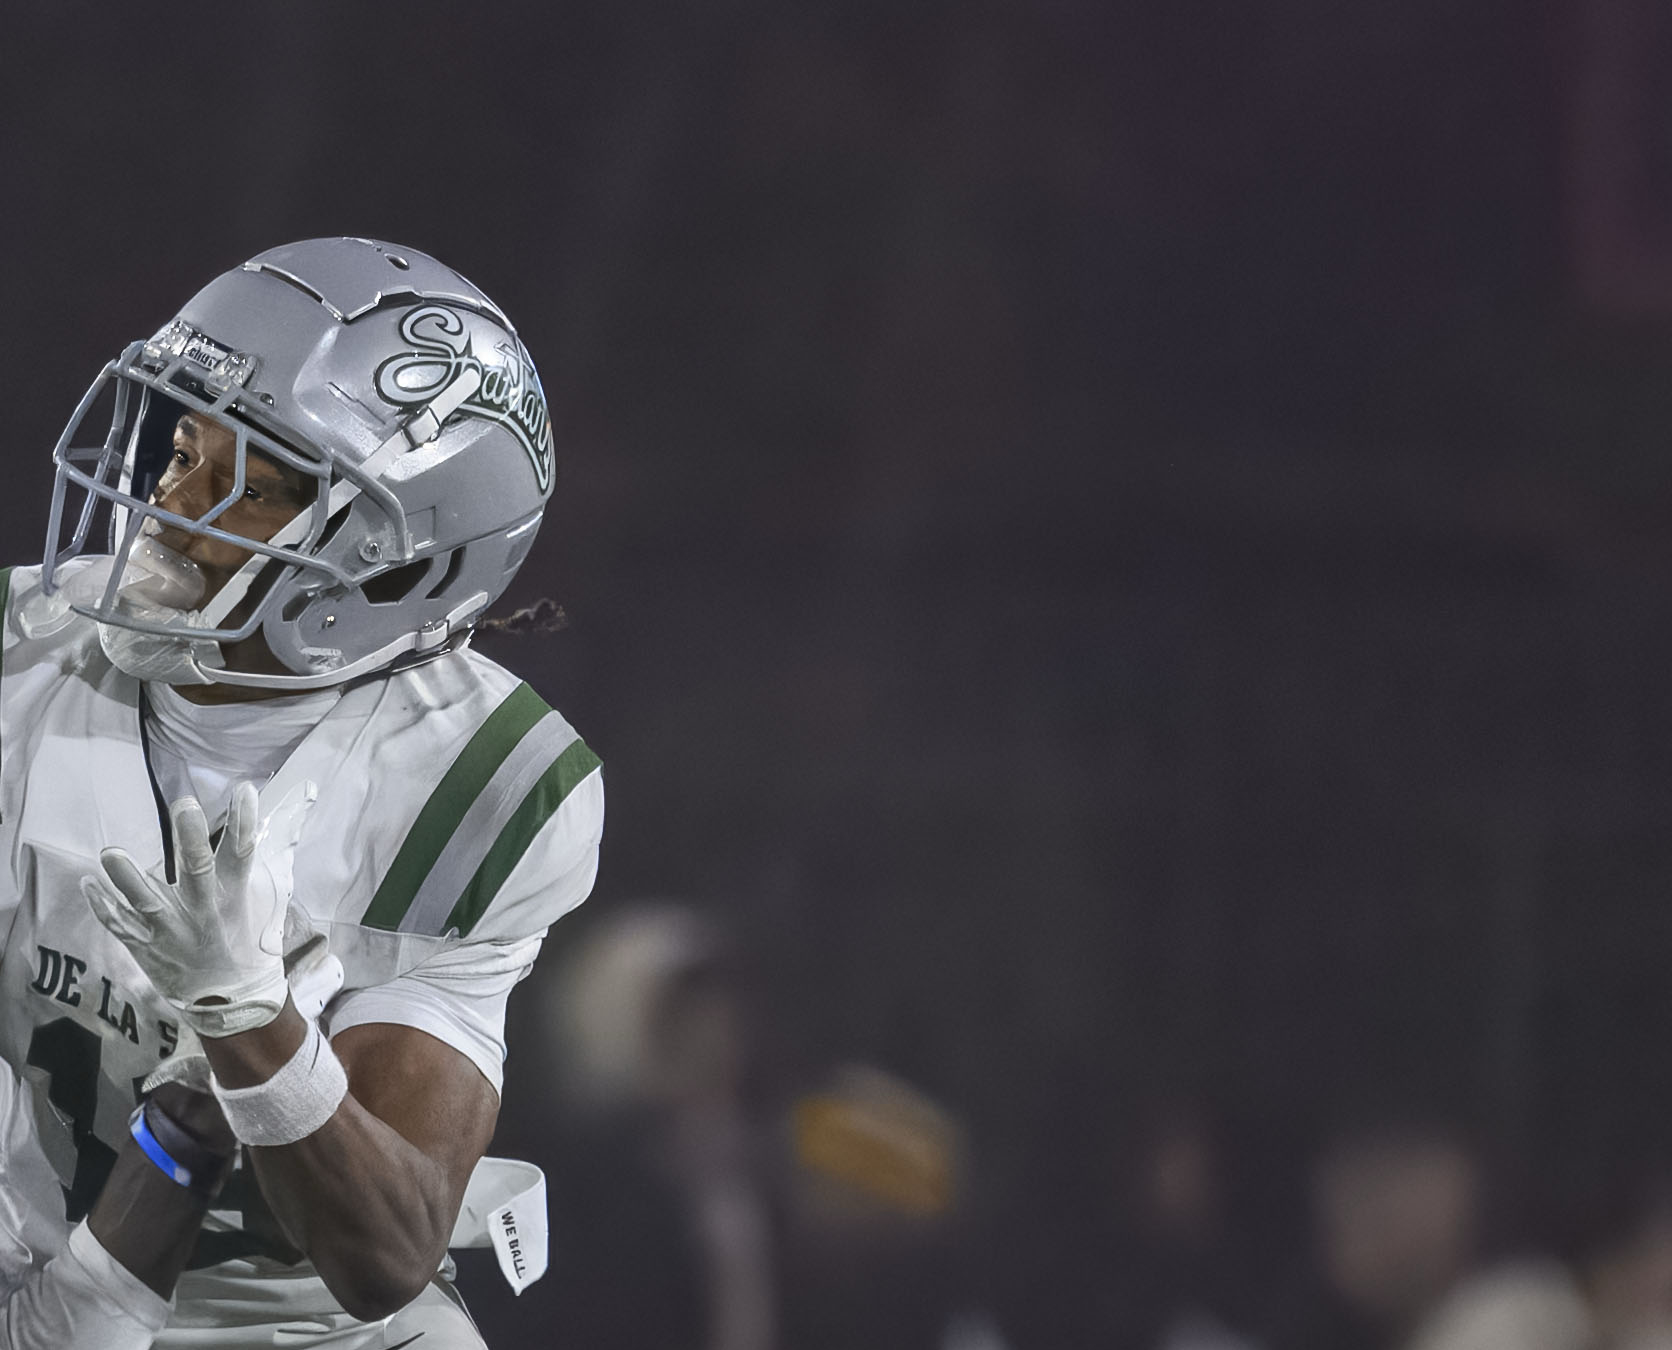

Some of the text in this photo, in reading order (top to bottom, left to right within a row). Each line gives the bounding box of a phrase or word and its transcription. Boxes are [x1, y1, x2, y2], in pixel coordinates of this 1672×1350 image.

[30, 944, 88, 1008] DE
[96, 975, 140, 1046] LA
[501, 1210, 526, 1280] WE BALL
